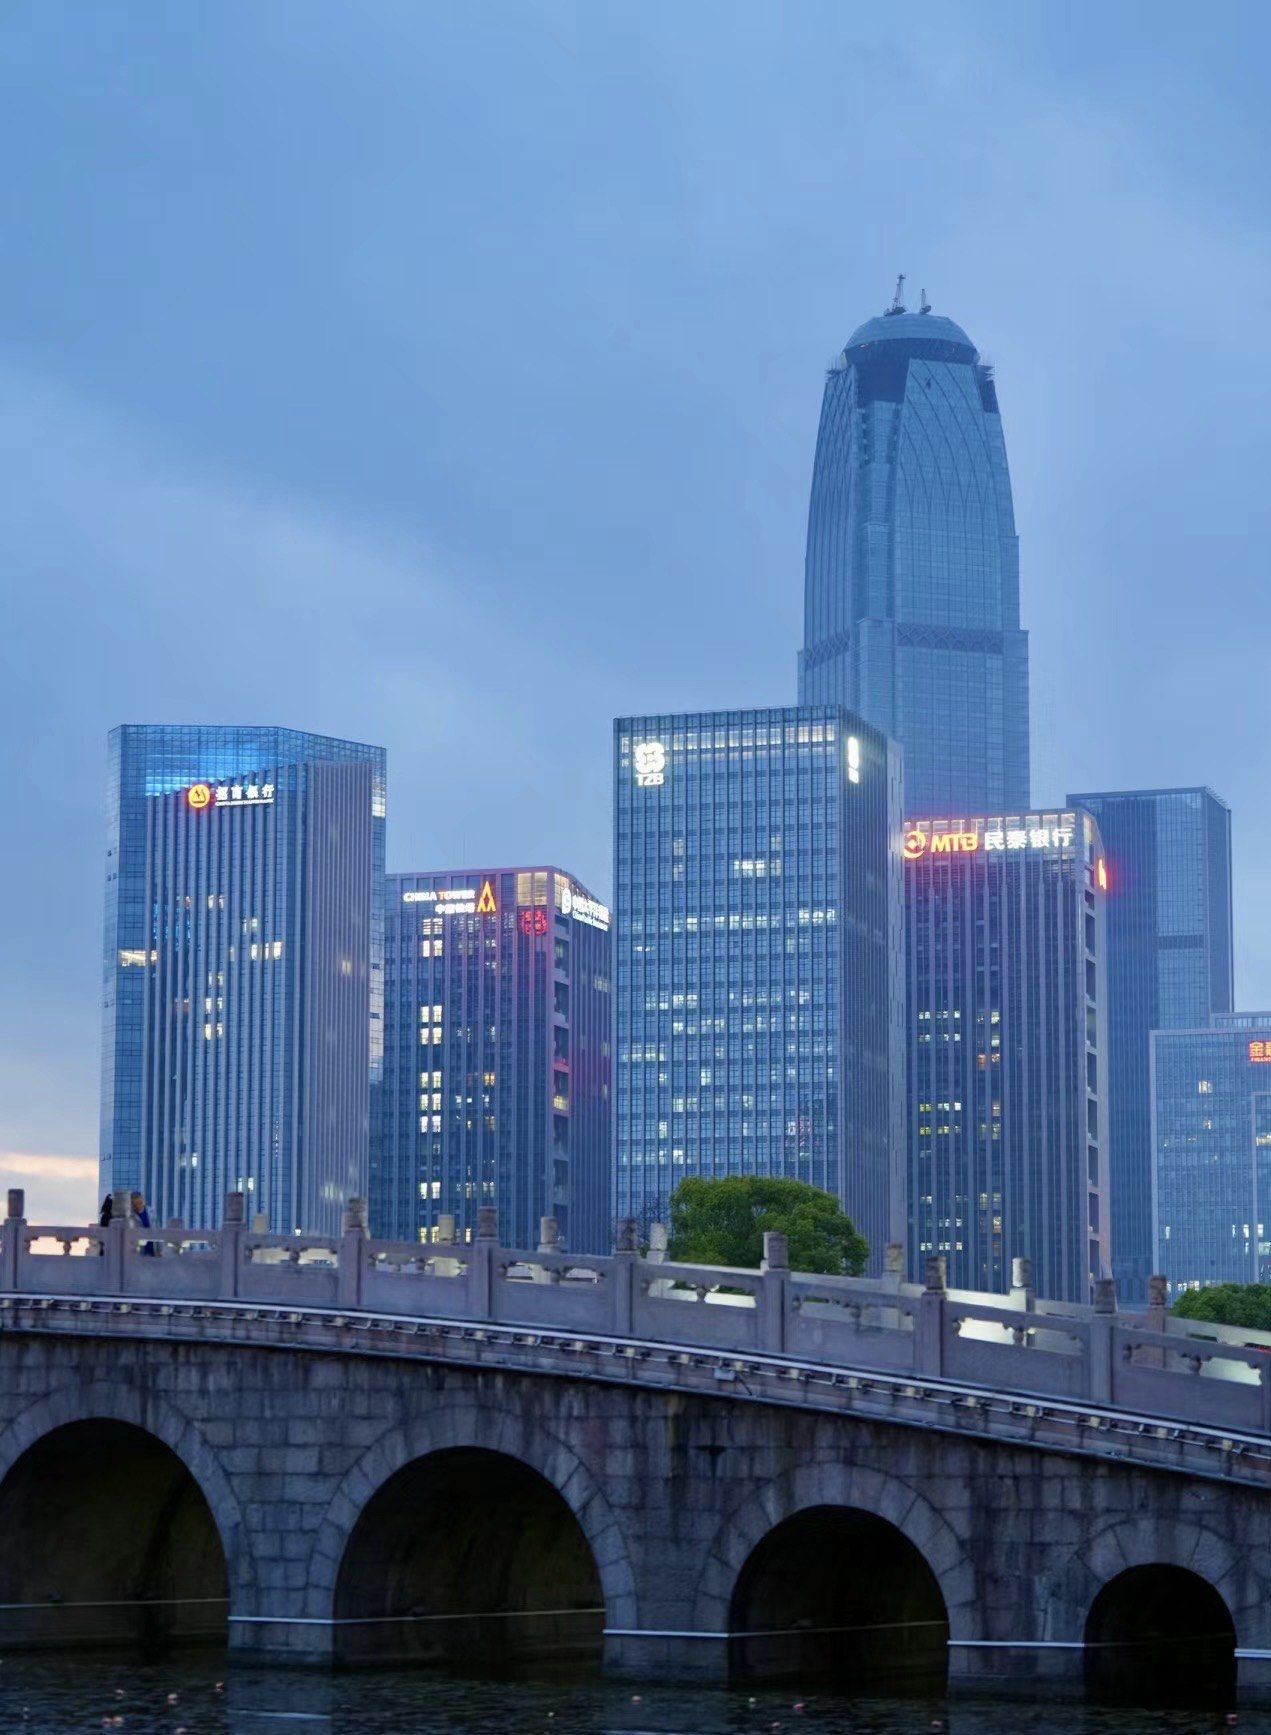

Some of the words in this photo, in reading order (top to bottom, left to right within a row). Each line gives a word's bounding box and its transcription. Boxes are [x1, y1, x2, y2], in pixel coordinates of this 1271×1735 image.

[931, 832, 978, 852] MTB
[984, 828, 1072, 850] 民泰银行
[403, 891, 437, 902] CHINA
[438, 889, 476, 900] TOWER
